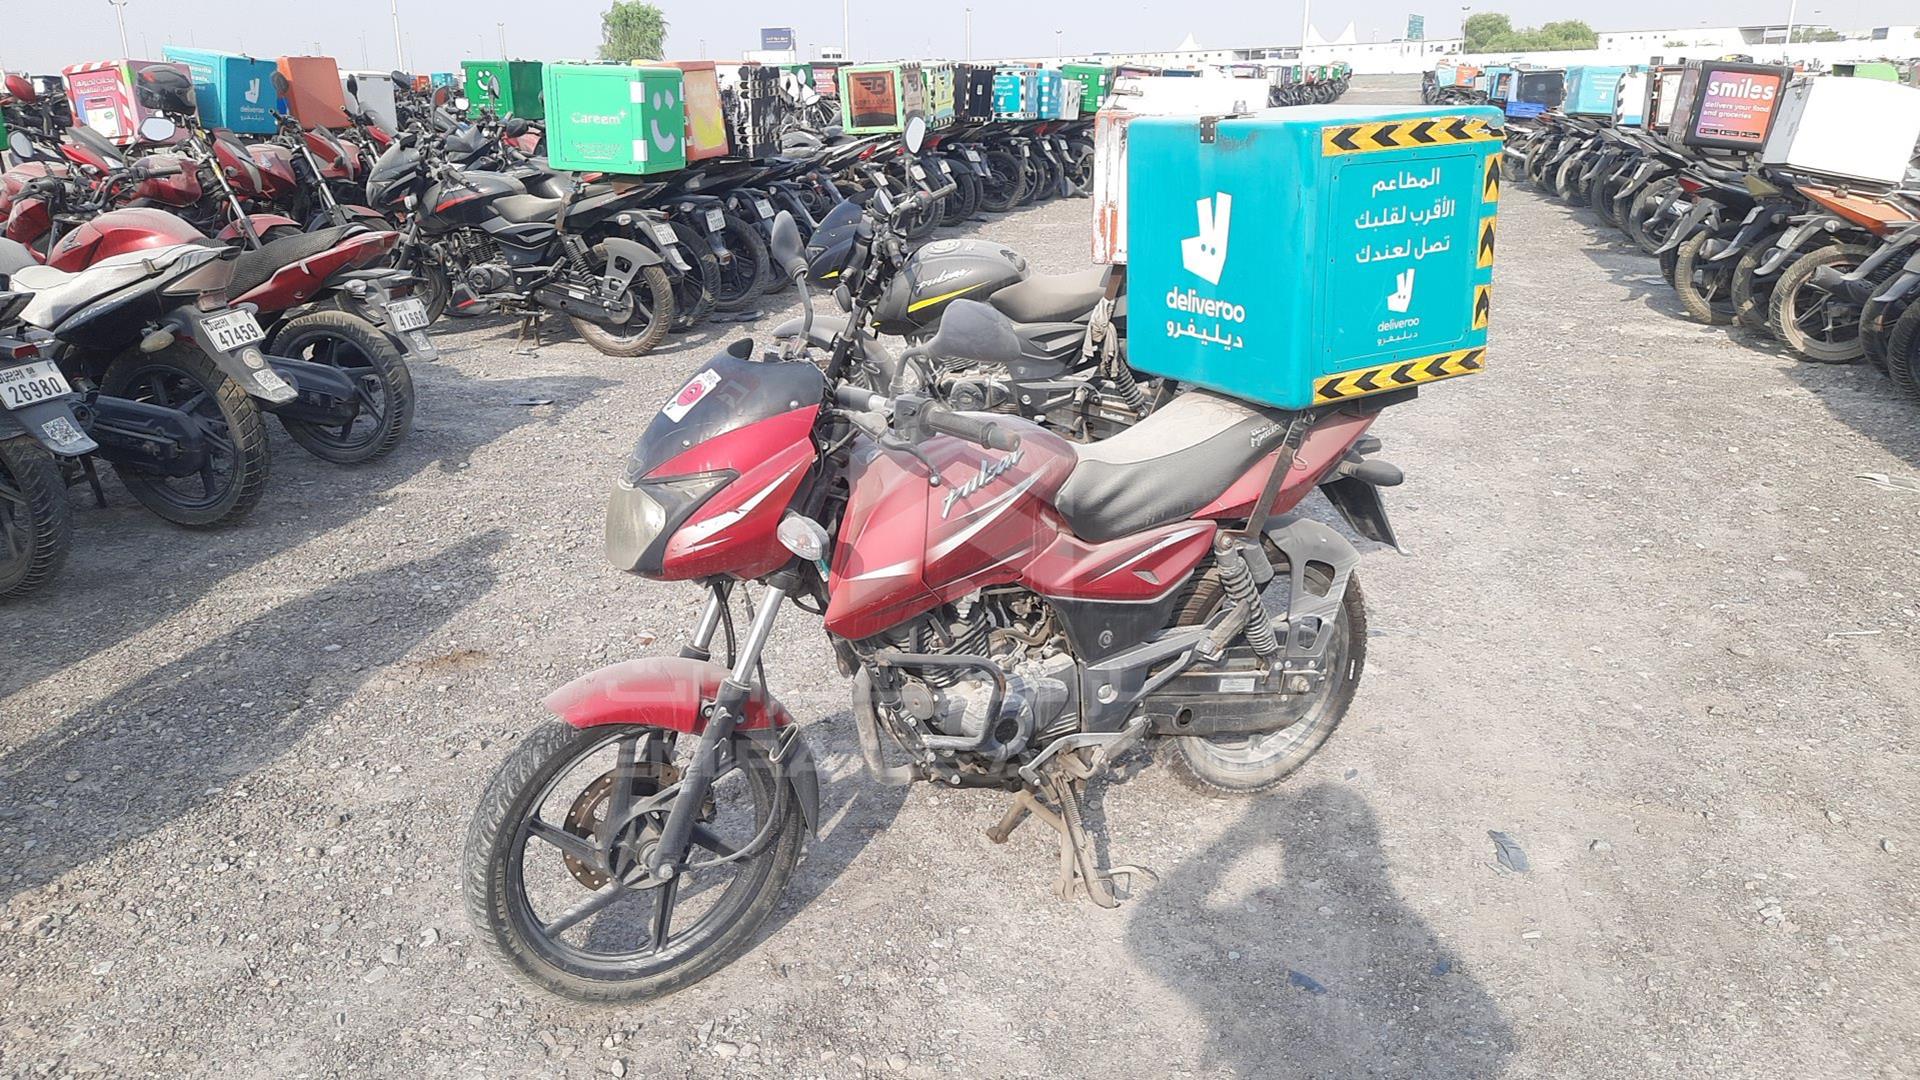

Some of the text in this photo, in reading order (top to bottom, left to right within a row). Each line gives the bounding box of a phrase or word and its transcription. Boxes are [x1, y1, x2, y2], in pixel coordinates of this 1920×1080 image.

[1708, 78, 1774, 100] smiles
[1705, 102, 1733, 110] delivers
[1734, 104, 1751, 112] your
[1718, 111, 1752, 120] groceries
[1372, 167, 1440, 196] المطاعم
[1354, 198, 1455, 230] الأقرب لقلبك
[1355, 236, 1450, 264] تصل لعندك
[1166, 286, 1246, 323] deliveroo
[218, 323, 259, 347] 47459
[1166, 319, 1243, 349] ديليفرو
[1377, 317, 1420, 332] deliveroo
[1377, 331, 1418, 347] ديليفرو
[8, 377, 62, 404] 26980
